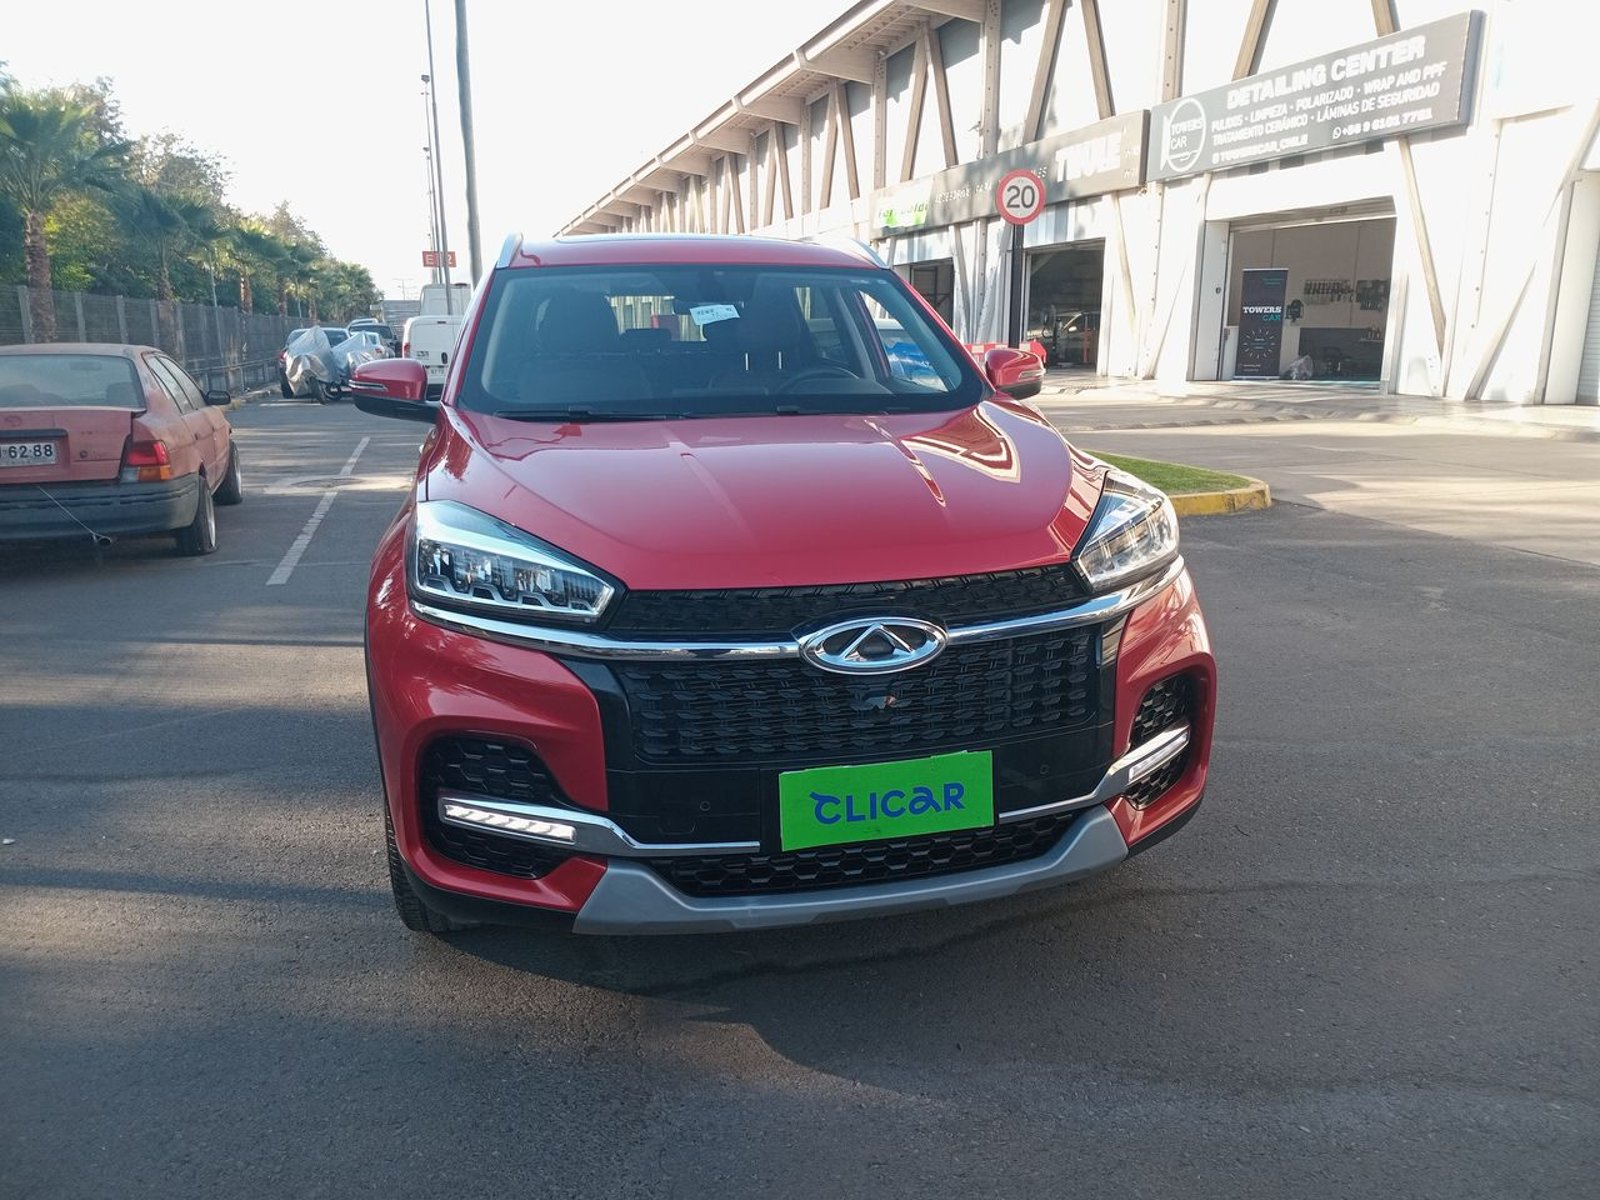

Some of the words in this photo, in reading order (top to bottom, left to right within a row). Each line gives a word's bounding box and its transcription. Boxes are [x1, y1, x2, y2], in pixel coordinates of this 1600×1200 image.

[1227, 64, 1326, 110] DETAILING
[1331, 35, 1426, 81] CENTER
[1211, 115, 1243, 133] PULIDOS
[1250, 103, 1288, 123] LIMPIEZA
[1296, 86, 1354, 111] POLARIZADO
[1363, 75, 1395, 95] WRAP
[1396, 69, 1421, 87] AND
[1422, 61, 1448, 80] PPF
[1212, 125, 1264, 146] TRATAMIENTO
[1265, 114, 1308, 134] CERÁMICO
[1316, 101, 1359, 123] LÁMINAS
[1361, 97, 1376, 113] DE
[1377, 82, 1440, 109] SEGURIDAD
[1171, 118, 1202, 136] TOWERS
[1170, 135, 1188, 151] CAR
[1006, 184, 1036, 209] 20
[425, 254, 453, 265] E2
[1242, 306, 1282, 314] TOWERS
